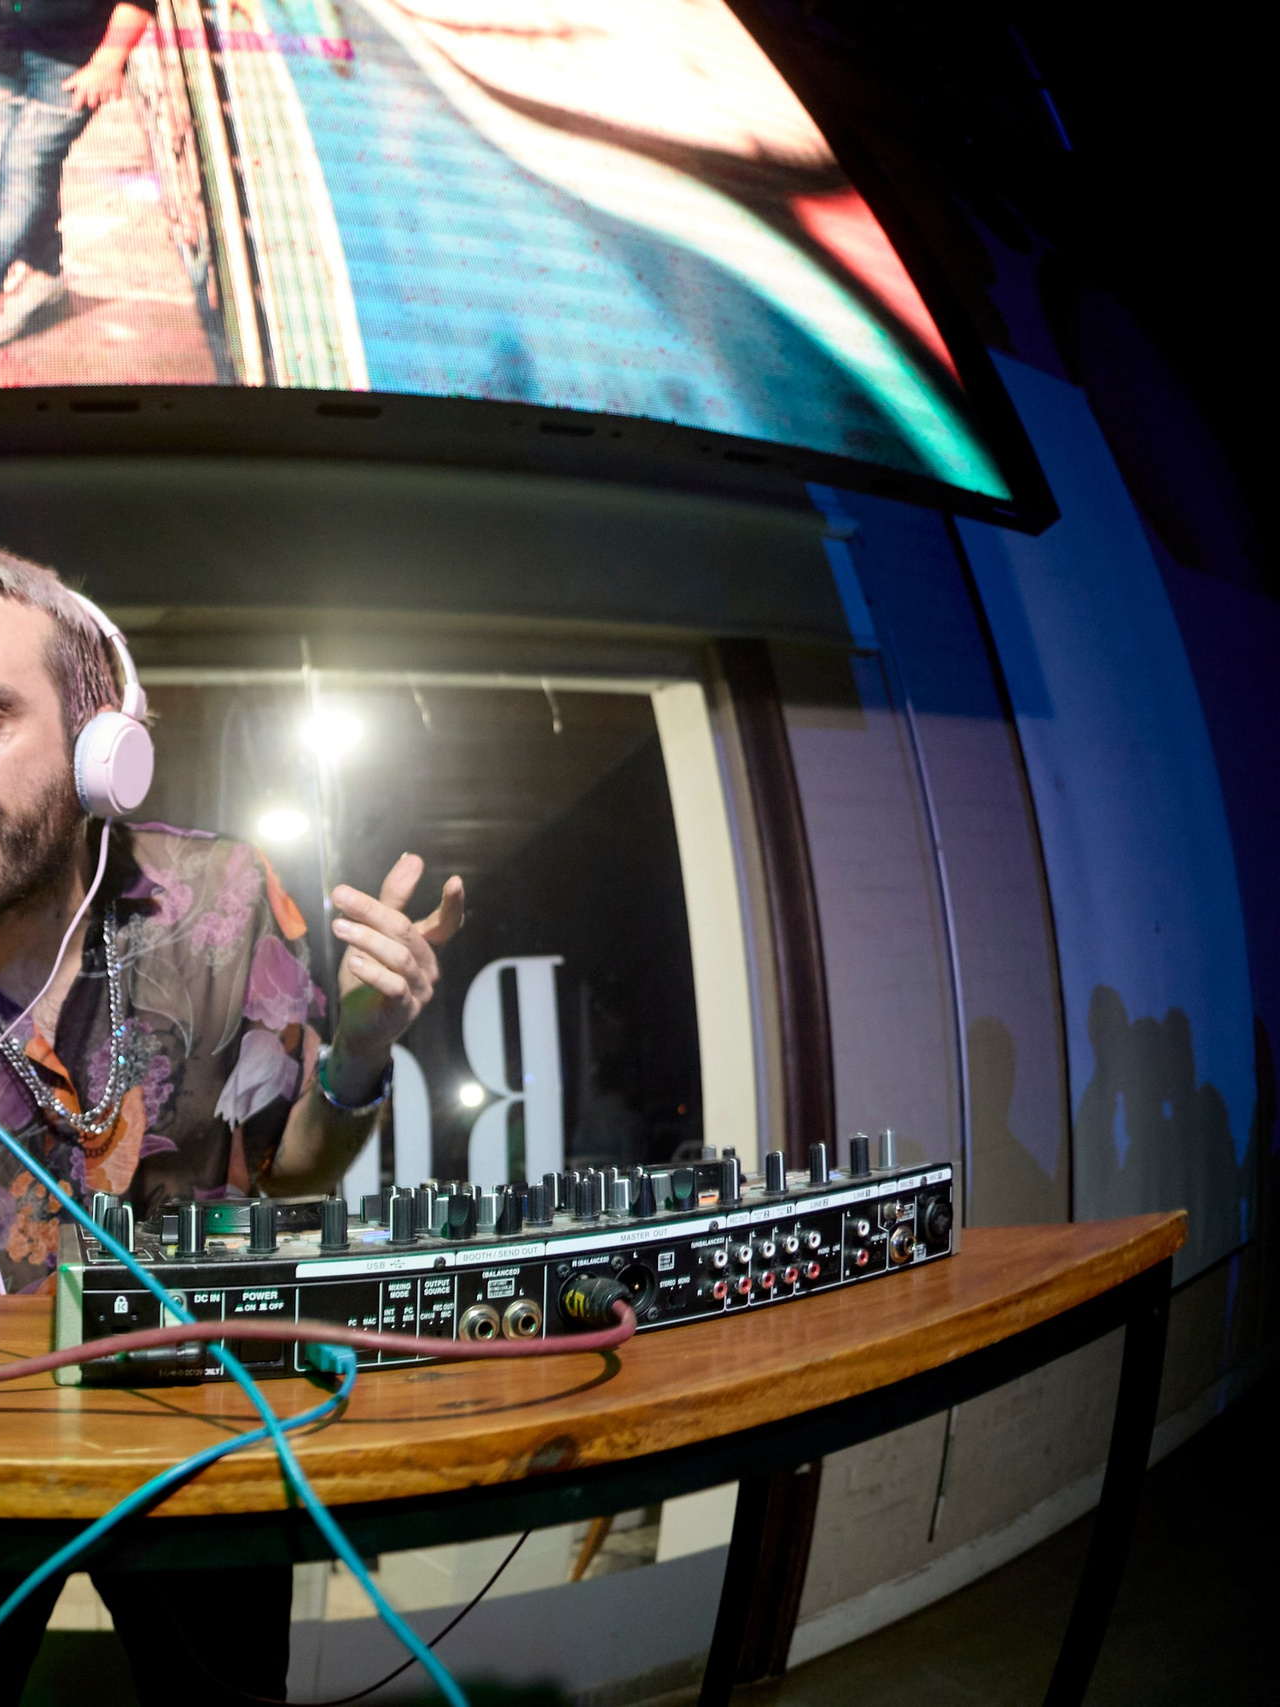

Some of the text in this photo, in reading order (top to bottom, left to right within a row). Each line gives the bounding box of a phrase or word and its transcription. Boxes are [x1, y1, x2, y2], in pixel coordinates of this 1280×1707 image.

[810, 1199, 823, 1209] LINE
[620, 1229, 668, 1241] MASTER OUT
[463, 1252, 492, 1261] BOOTH
[499, 1249, 520, 1258] SEND
[522, 1247, 538, 1255] OUT
[366, 1262, 386, 1271] USB
[482, 1267, 520, 1279] (BALANCED)
[388, 1282, 412, 1292] MIXING
[424, 1278, 451, 1288] OUTPUT
[242, 1291, 279, 1301] POWER
[390, 1291, 410, 1299] MODE
[423, 1286, 450, 1296] SOURCE
[193, 1292, 221, 1303] DC IN
[244, 1303, 256, 1312] ON
[268, 1302, 285, 1311] OFF
[404, 1306, 414, 1315] PC
[347, 1318, 358, 1327] PC
[362, 1317, 377, 1326] MAC
